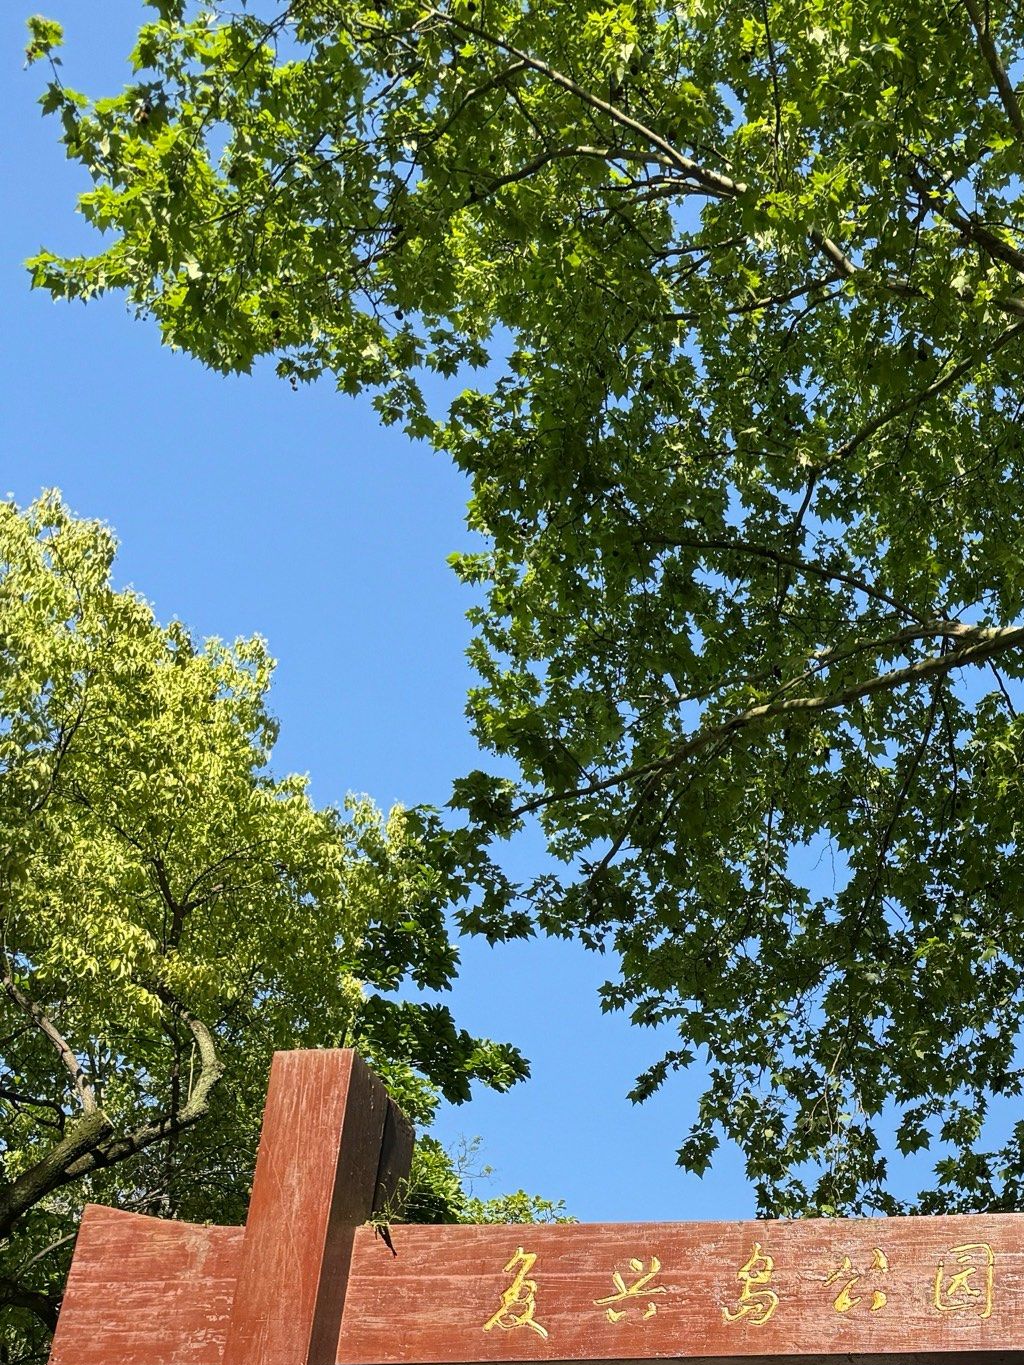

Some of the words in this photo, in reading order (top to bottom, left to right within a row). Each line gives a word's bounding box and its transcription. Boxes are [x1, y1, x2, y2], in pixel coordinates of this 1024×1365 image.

[483, 1241, 995, 1340] 复兴岛公园
